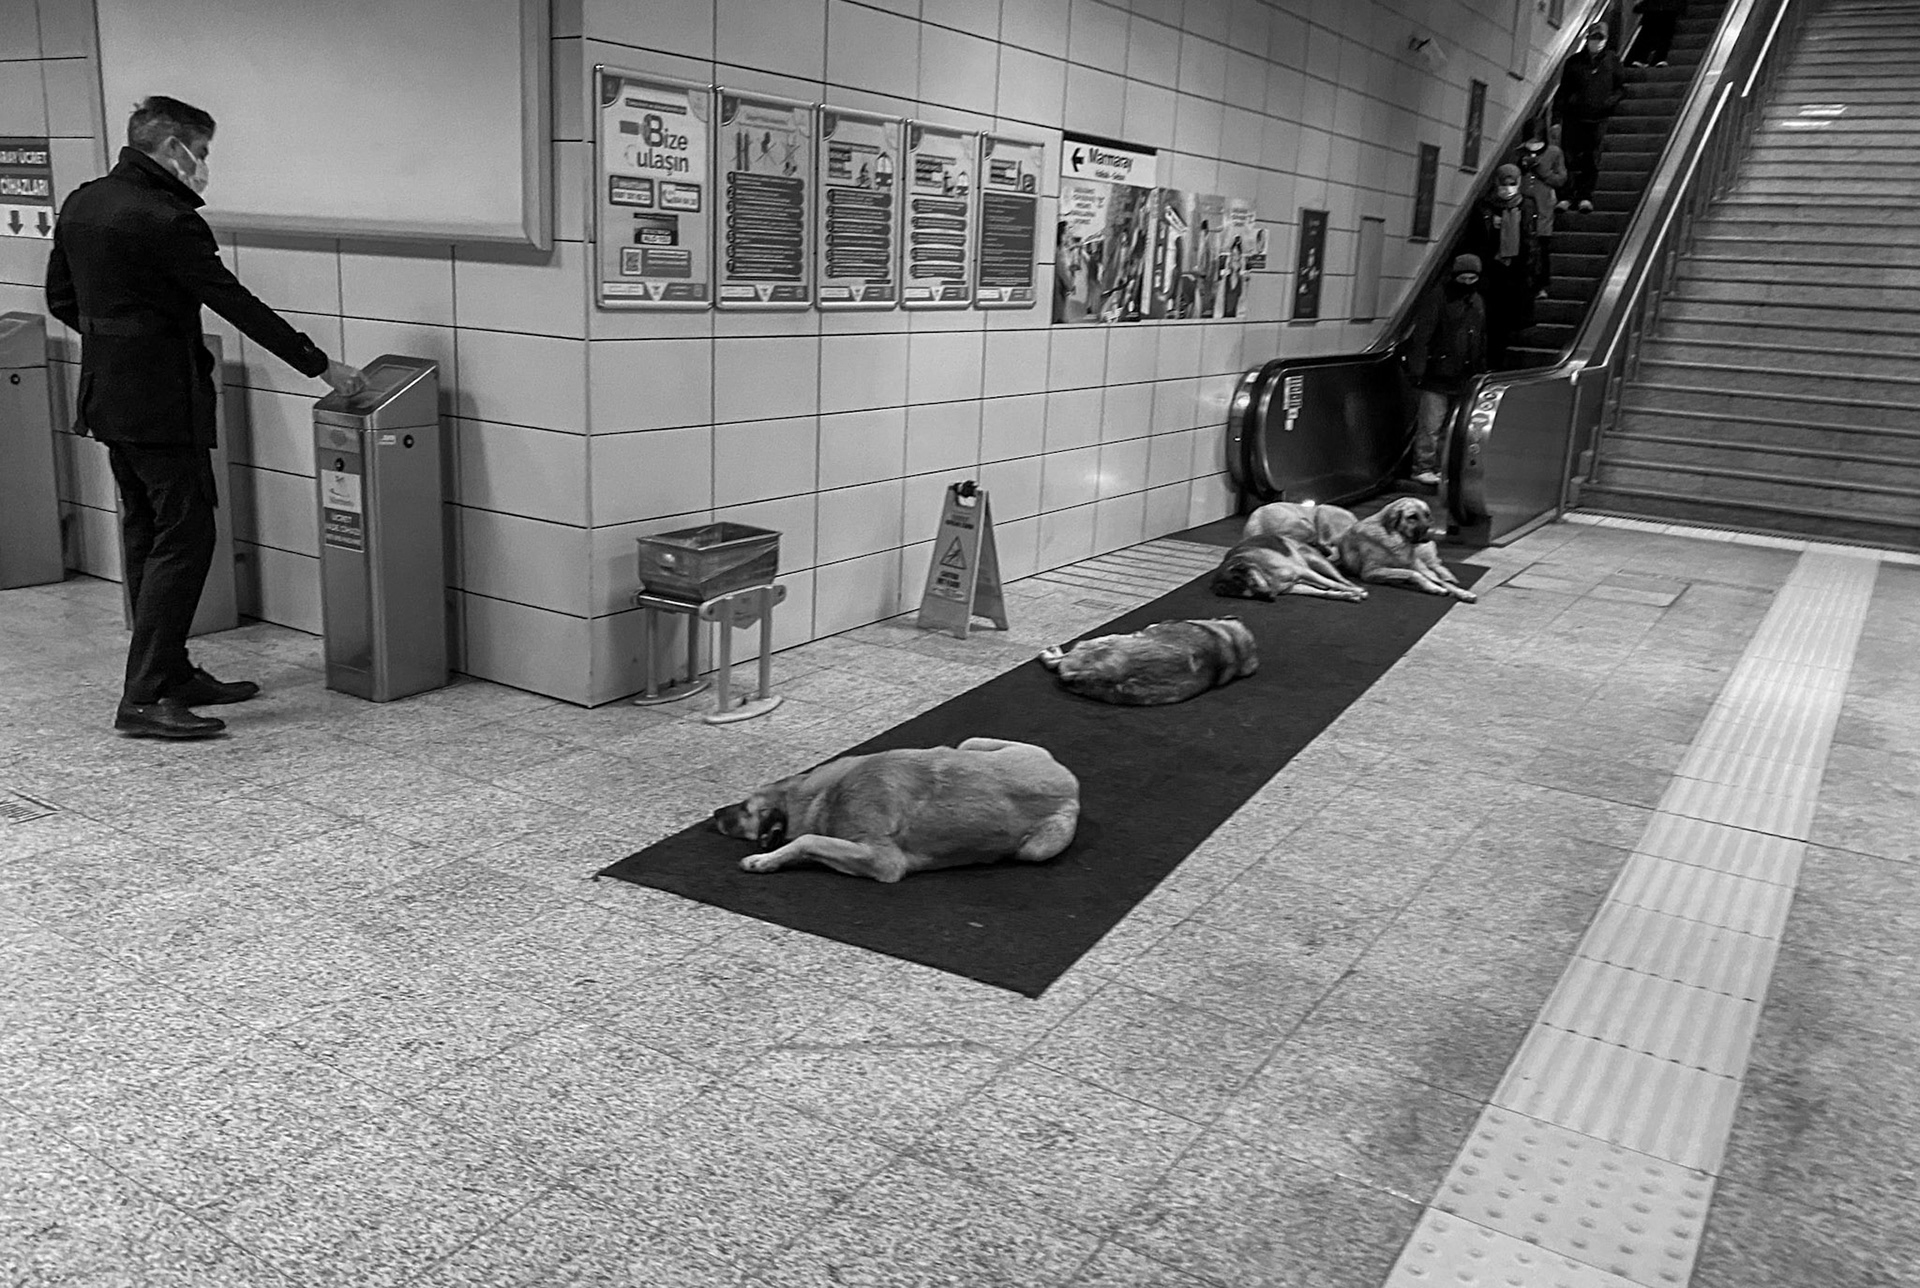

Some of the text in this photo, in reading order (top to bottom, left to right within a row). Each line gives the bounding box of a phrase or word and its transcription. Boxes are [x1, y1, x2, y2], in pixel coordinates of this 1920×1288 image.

[642, 114, 689, 151] Bize
[636, 147, 689, 176] ulaşın
[1088, 147, 1134, 174] Marmaray
